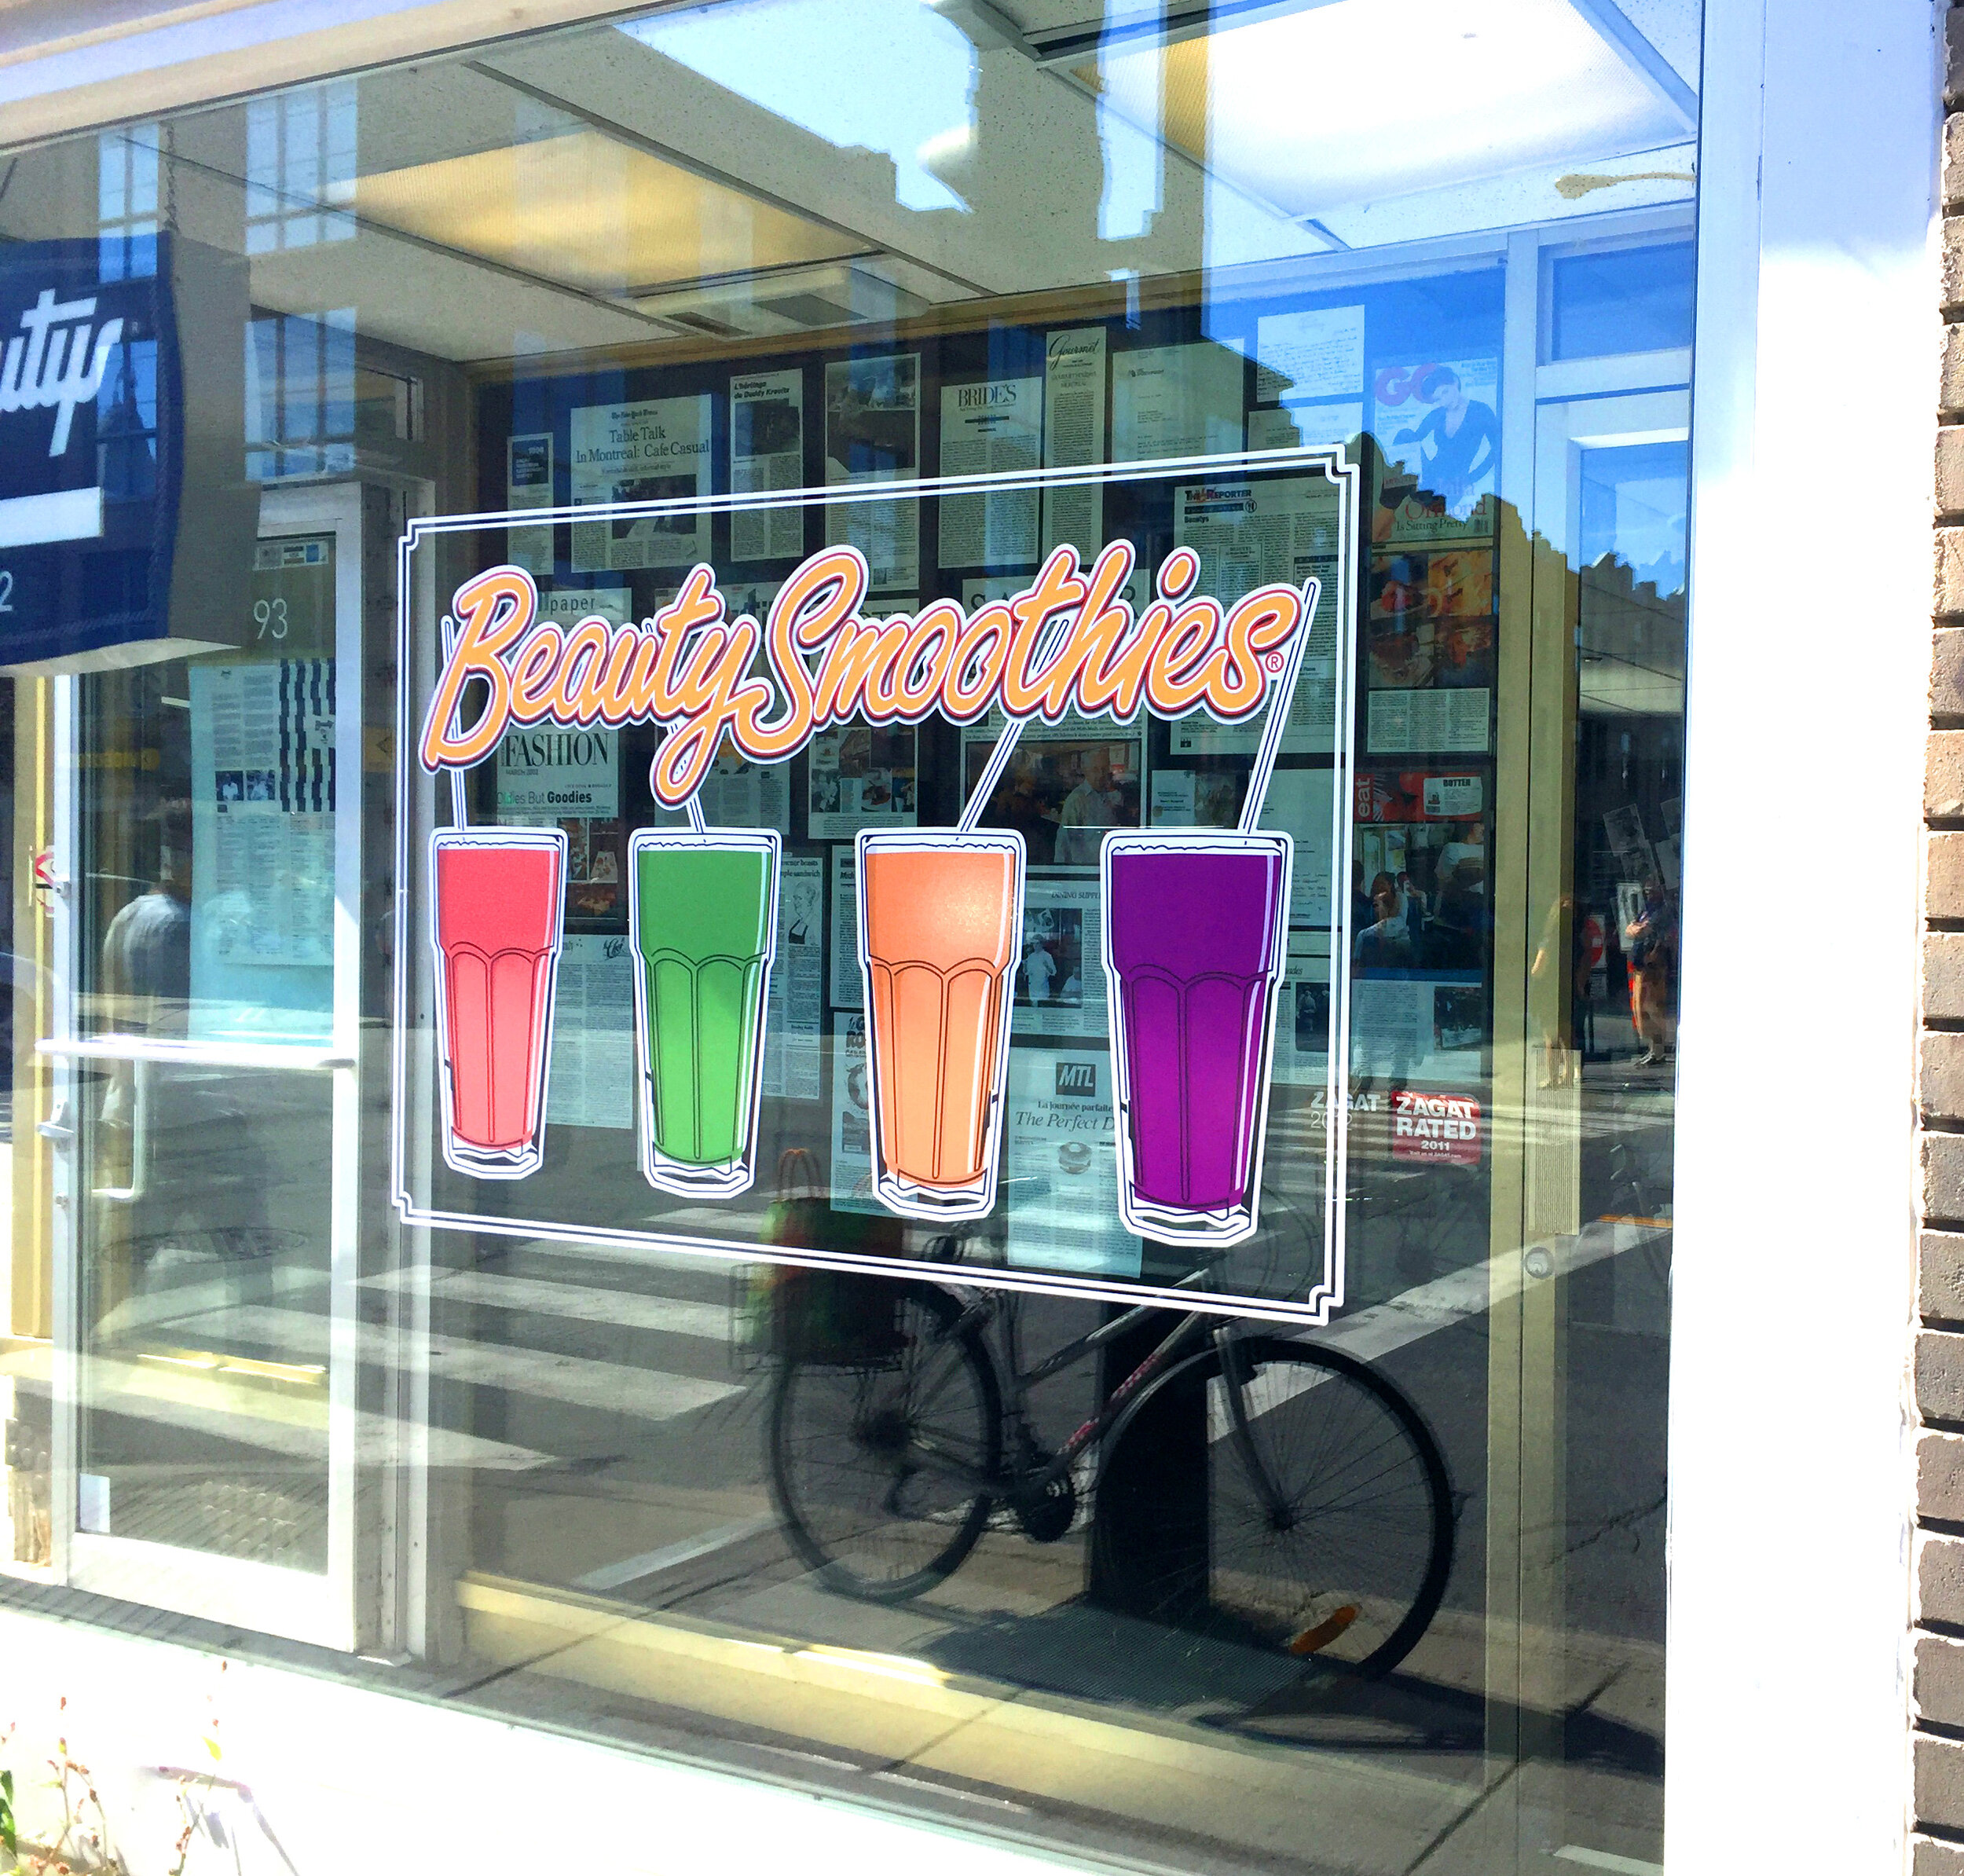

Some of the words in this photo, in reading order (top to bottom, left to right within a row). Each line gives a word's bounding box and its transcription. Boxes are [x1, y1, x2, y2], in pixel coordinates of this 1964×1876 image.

[1048, 334, 1099, 371] Gourmet
[958, 384, 1017, 407] BRIDE'S
[608, 428, 639, 443] Table
[640, 425, 666, 440] Talk
[576, 450, 587, 464] In
[589, 445, 639, 462] Montreal:
[644, 443, 669, 457] Cafe
[671, 439, 709, 456] Casual
[1396, 521, 1405, 531] Is
[1406, 520, 1438, 533] Sitting
[253, 598, 288, 639] 93
[424, 564, 756, 810] Beauty
[731, 544, 1303, 760] Smoothies
[504, 732, 610, 767] FASHION
[528, 791, 545, 804] But
[548, 790, 592, 804] Goodies
[1357, 778, 1370, 817] eat
[1059, 1064, 1094, 1087] MTL
[1038, 1101, 1048, 1109] La
[1311, 1091, 1381, 1112] ZGAT
[1396, 1097, 1475, 1119] ZAGAT
[1016, 1112, 1043, 1127] The
[1047, 1113, 1098, 1132] Perfect
[1396, 1117, 1476, 1140] RATED
[1420, 1140, 1449, 1151] 2011
